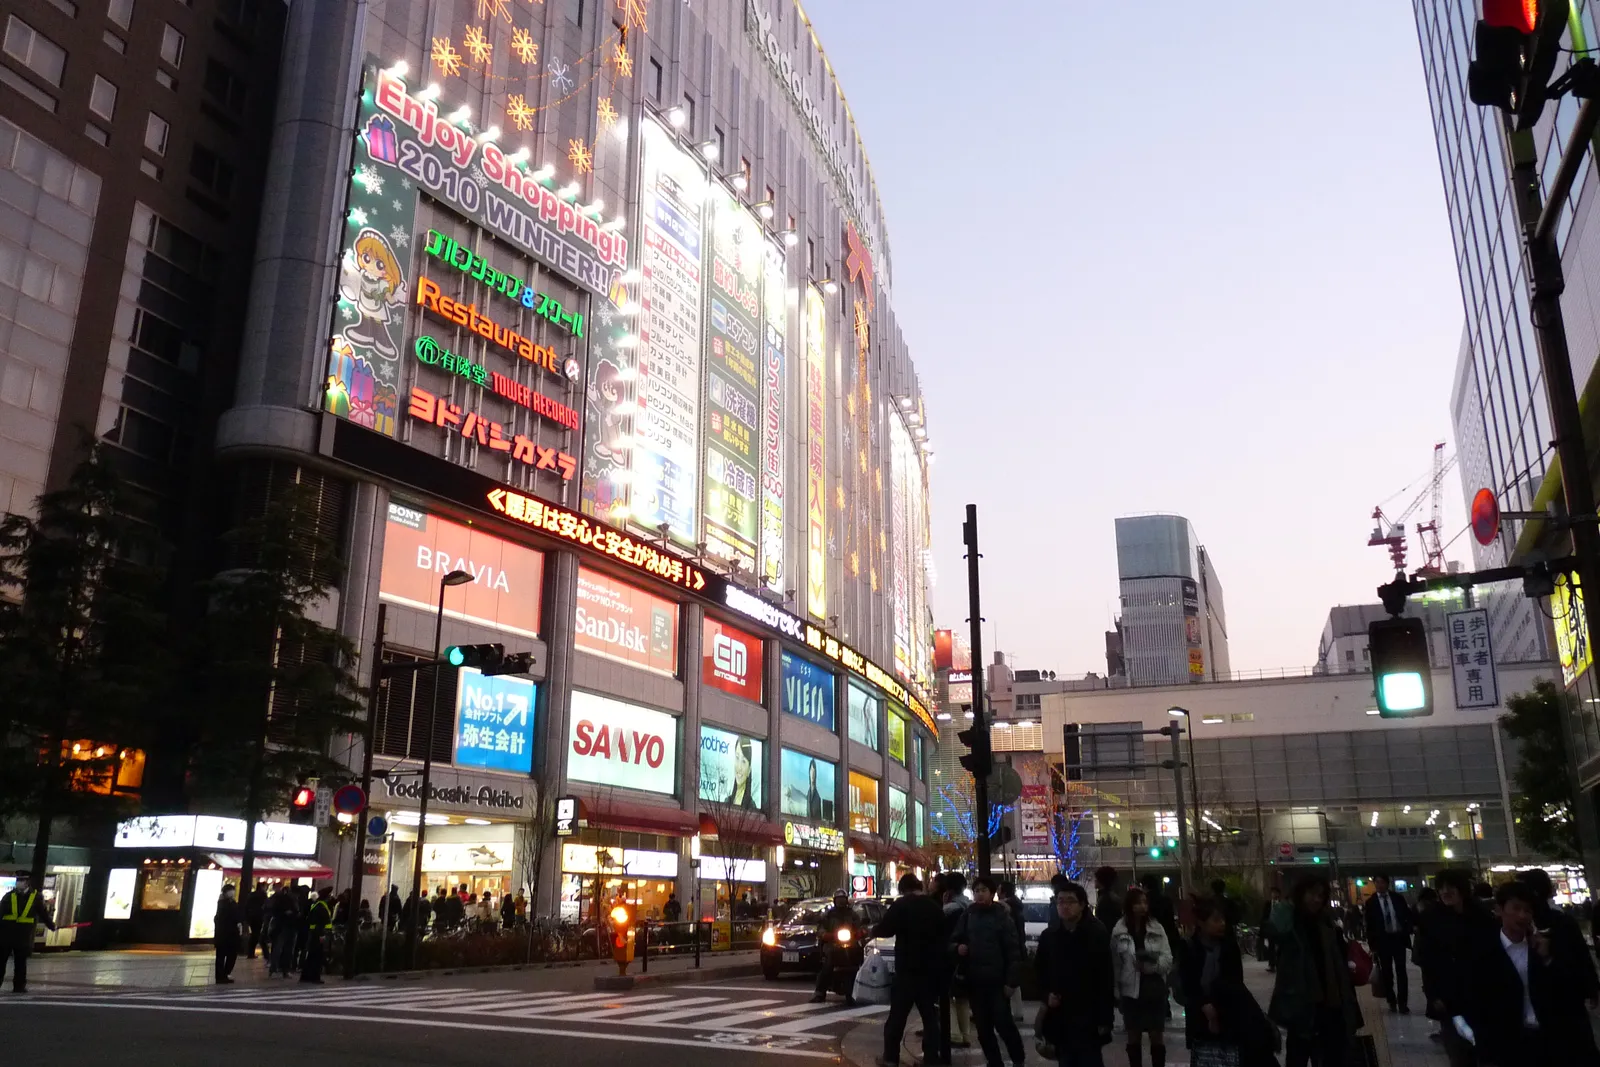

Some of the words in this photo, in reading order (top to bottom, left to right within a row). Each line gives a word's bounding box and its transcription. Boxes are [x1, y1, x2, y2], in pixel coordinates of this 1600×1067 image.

[376, 68, 477, 168] Enjoy
[481, 142, 629, 270] Shopping!!
[399, 141, 481, 213] 2010
[485, 189, 609, 297] WINTER!!
[417, 275, 558, 373] Restaurant
[440, 348, 487, 387] 有隣堂
[491, 371, 530, 407] TOWER
[532, 393, 579, 431] RECORDS
[768, 346, 780, 478] レストラン街
[408, 386, 577, 481] ヨドバシカメラ
[810, 362, 823, 552] 駐車場入口
[724, 457, 756, 503] 冷蔵庫
[389, 504, 423, 522] SONY
[417, 545, 510, 593] BRAVIA
[575, 607, 647, 654] SanDisk
[1452, 618, 1471, 667] 自転車
[1469, 616, 1489, 666] 歩行者
[465, 685, 504, 713] No.1
[786, 675, 825, 723] VIERA
[1466, 668, 1484, 701] 専用
[463, 723, 526, 755] 弥生会計
[464, 707, 503, 724] 会計ソフト
[573, 719, 665, 769] SANYO
